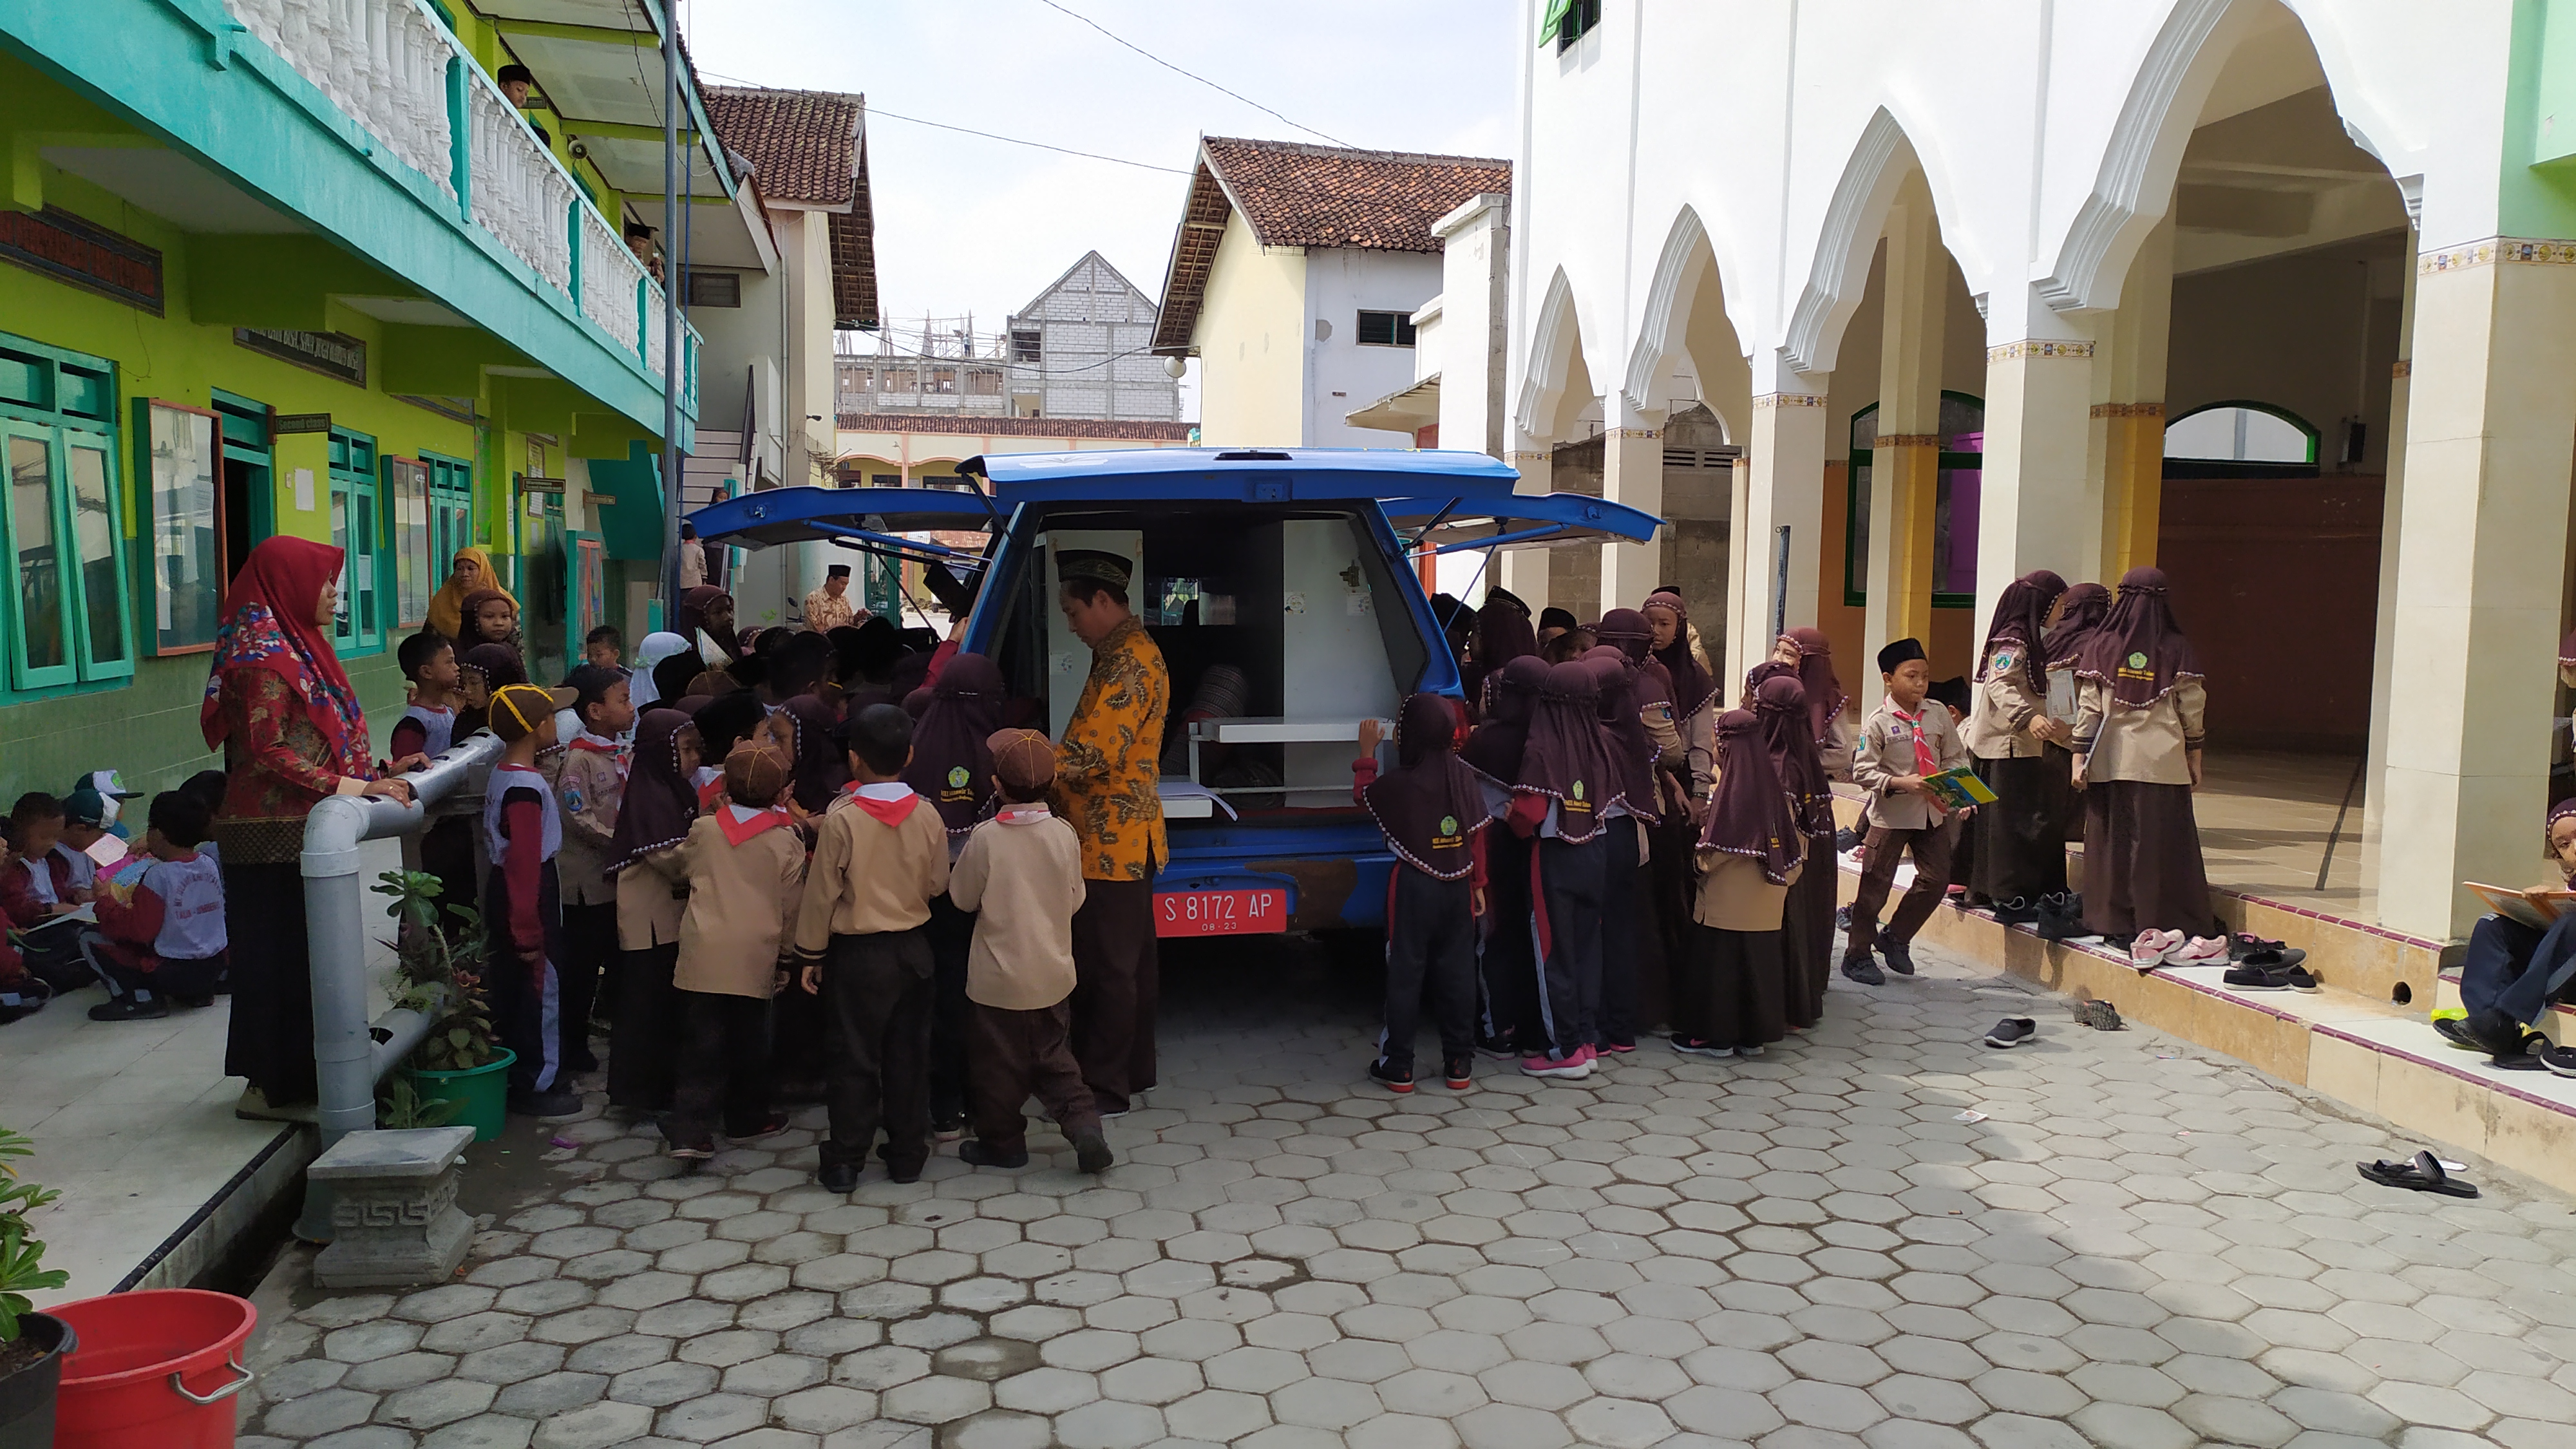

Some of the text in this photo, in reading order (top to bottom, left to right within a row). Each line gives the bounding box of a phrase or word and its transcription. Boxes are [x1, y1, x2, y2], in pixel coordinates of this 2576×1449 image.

[278, 417, 326, 431] Second class
[1164, 893, 1273, 922] S 8172 AP
